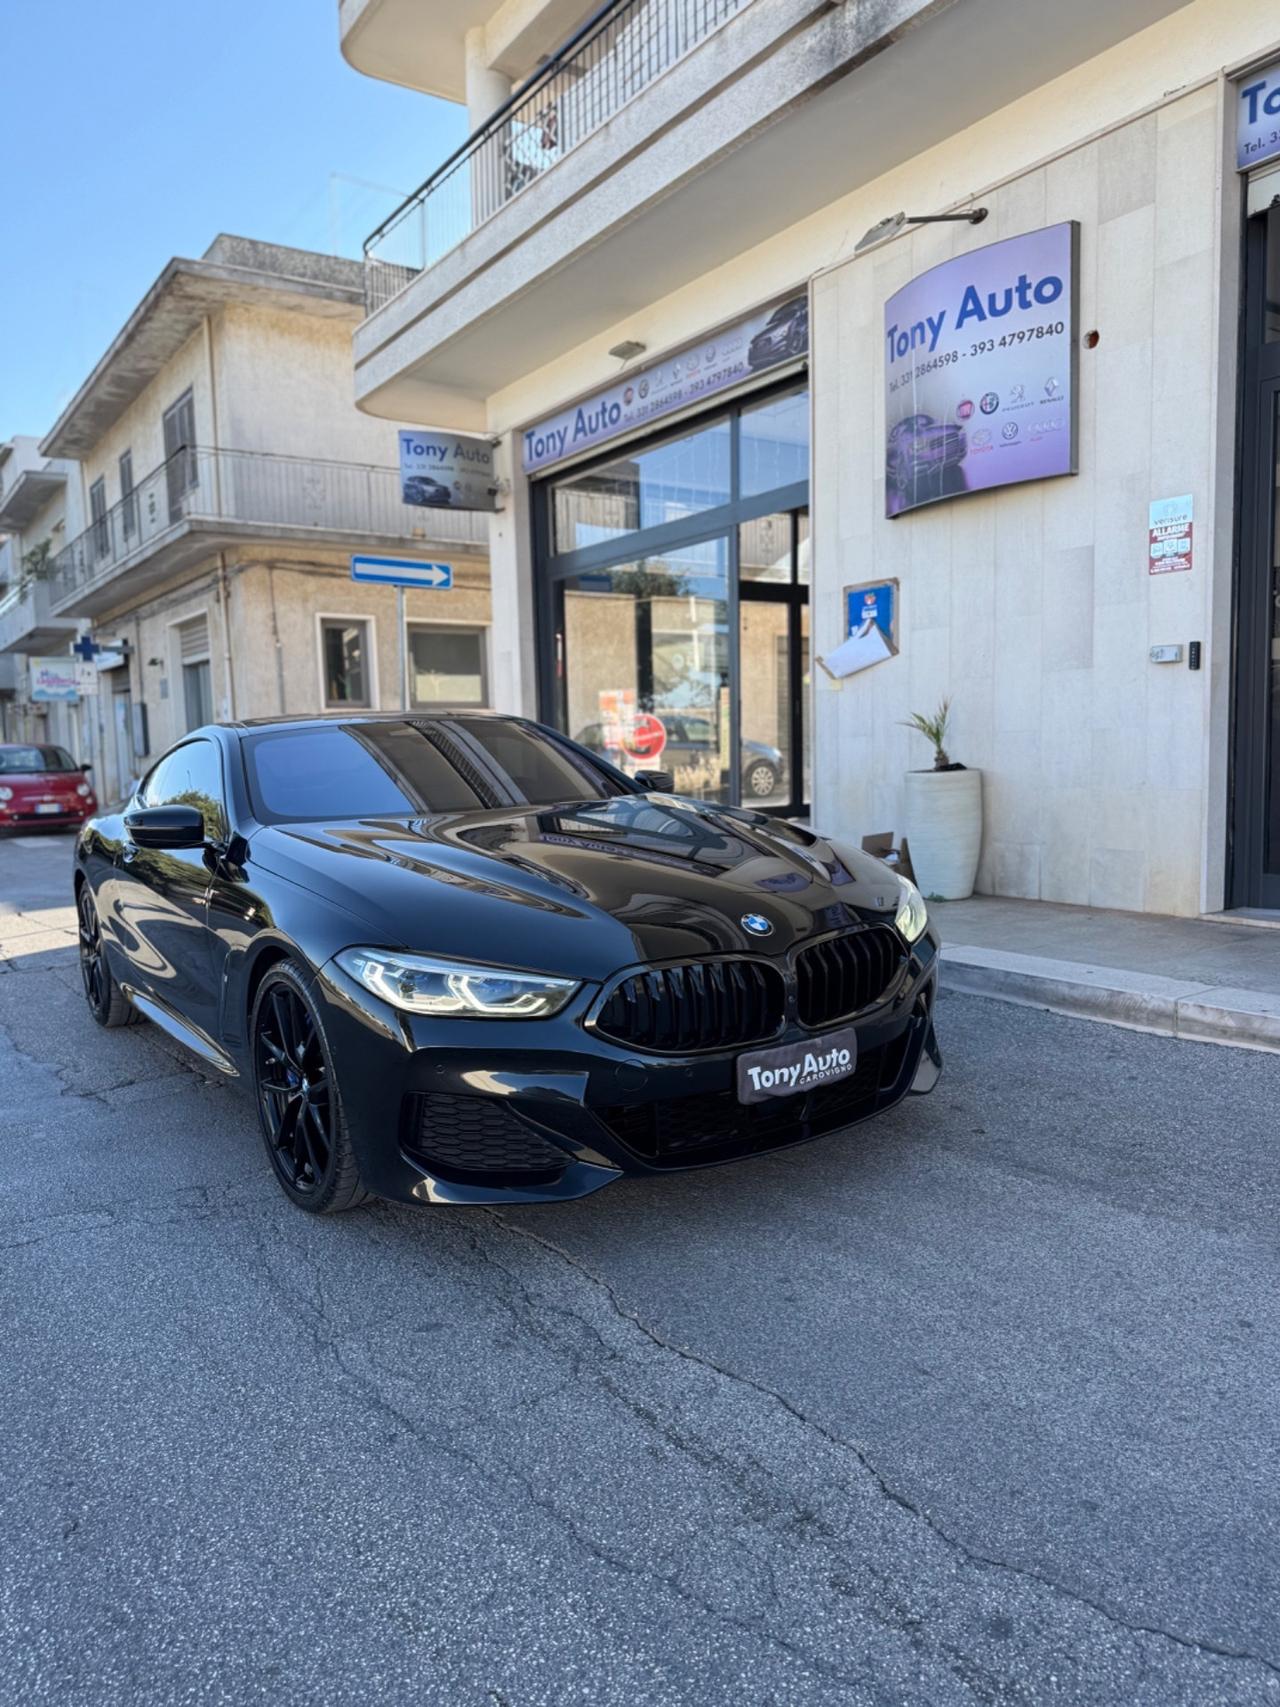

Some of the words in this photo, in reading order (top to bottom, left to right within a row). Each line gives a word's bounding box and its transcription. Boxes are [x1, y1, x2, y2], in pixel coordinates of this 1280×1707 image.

[1243, 137, 1265, 154] Tel.
[1270, 130, 1280, 143] 3
[887, 309, 946, 364] Tony
[955, 273, 1064, 330] Auto
[915, 350, 959, 379] 2864598
[970, 339, 995, 357] 393
[998, 321, 1065, 348] 4797840
[402, 438, 448, 462] Tony
[453, 442, 490, 464] Auto
[525, 424, 568, 462] Tony
[573, 401, 621, 442] Auto
[799, 1063, 853, 1085] CAROVIGNO
